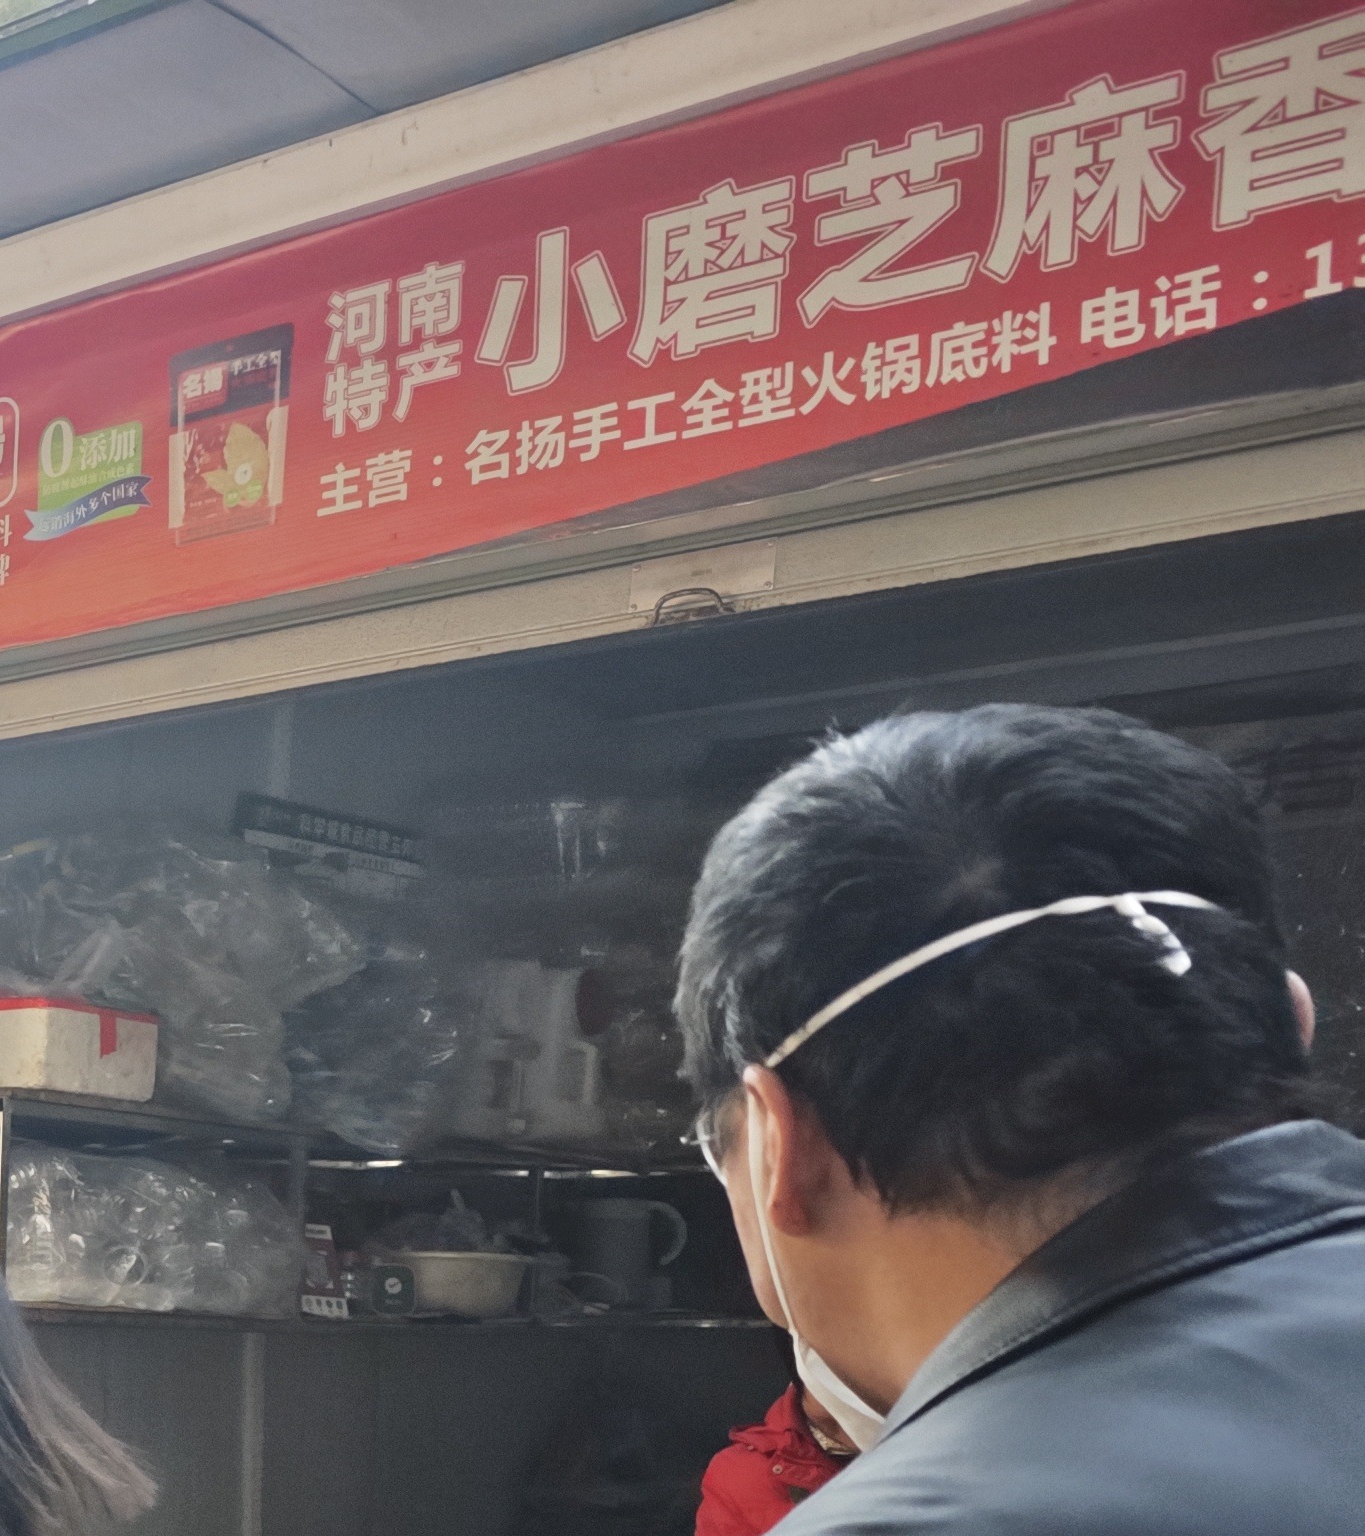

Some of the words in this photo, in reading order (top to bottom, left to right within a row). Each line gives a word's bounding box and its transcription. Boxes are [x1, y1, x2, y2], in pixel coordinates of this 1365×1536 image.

[476, 8, 1365, 395] 小磨芝麻香
[322, 340, 462, 438] 特产
[324, 262, 466, 366] 河南
[316, 307, 1057, 518] 主营：名扬手工全型火锅底料
